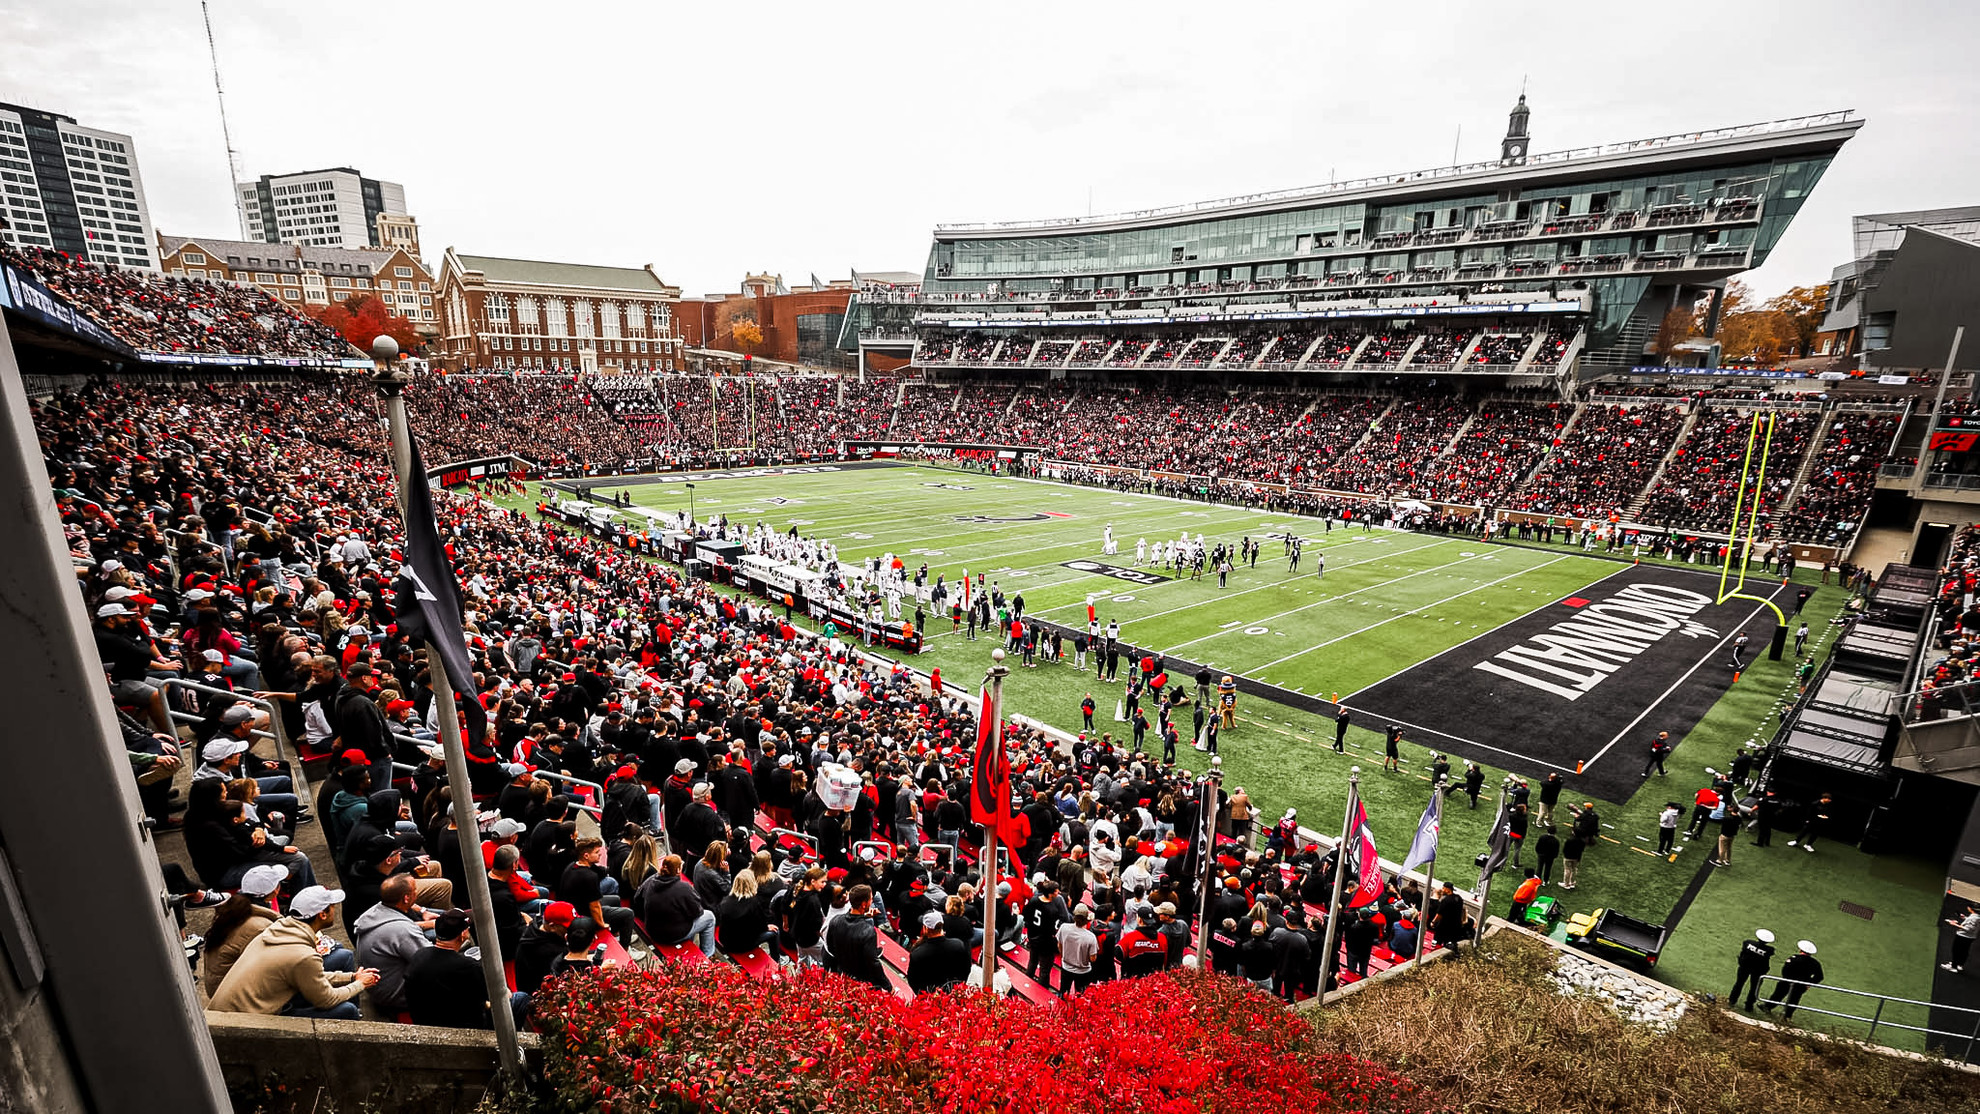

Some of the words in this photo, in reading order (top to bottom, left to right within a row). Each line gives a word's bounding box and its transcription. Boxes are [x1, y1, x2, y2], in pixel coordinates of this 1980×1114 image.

[954, 448, 996, 460] BEARCATS
[1472, 583, 1713, 702] CINCINNATI
[1032, 909, 1042, 927] 5
[1134, 940, 1159, 949] BEARCATS
[1746, 943, 1767, 957] POLICE
